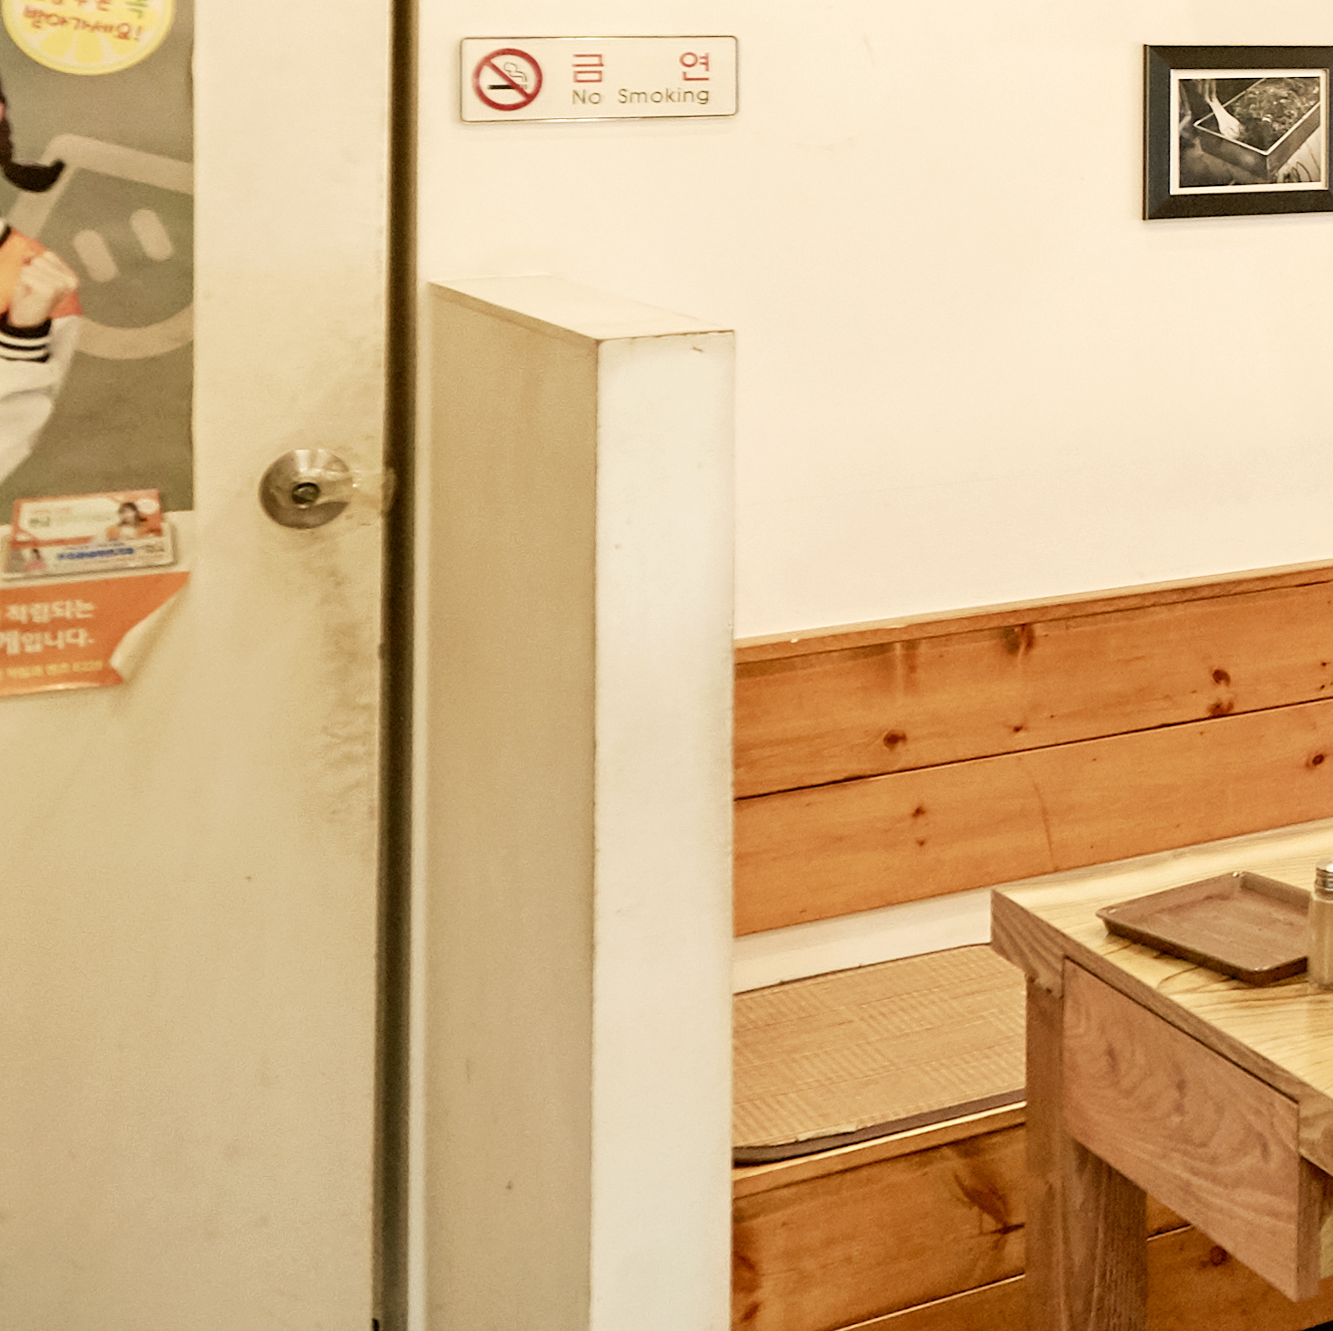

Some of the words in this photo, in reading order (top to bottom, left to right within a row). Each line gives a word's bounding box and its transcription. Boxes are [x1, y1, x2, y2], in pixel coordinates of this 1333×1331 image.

[572, 53, 604, 83] 금
[679, 52, 710, 81] 연
[572, 89, 601, 105] No
[618, 87, 710, 105] Smoking
